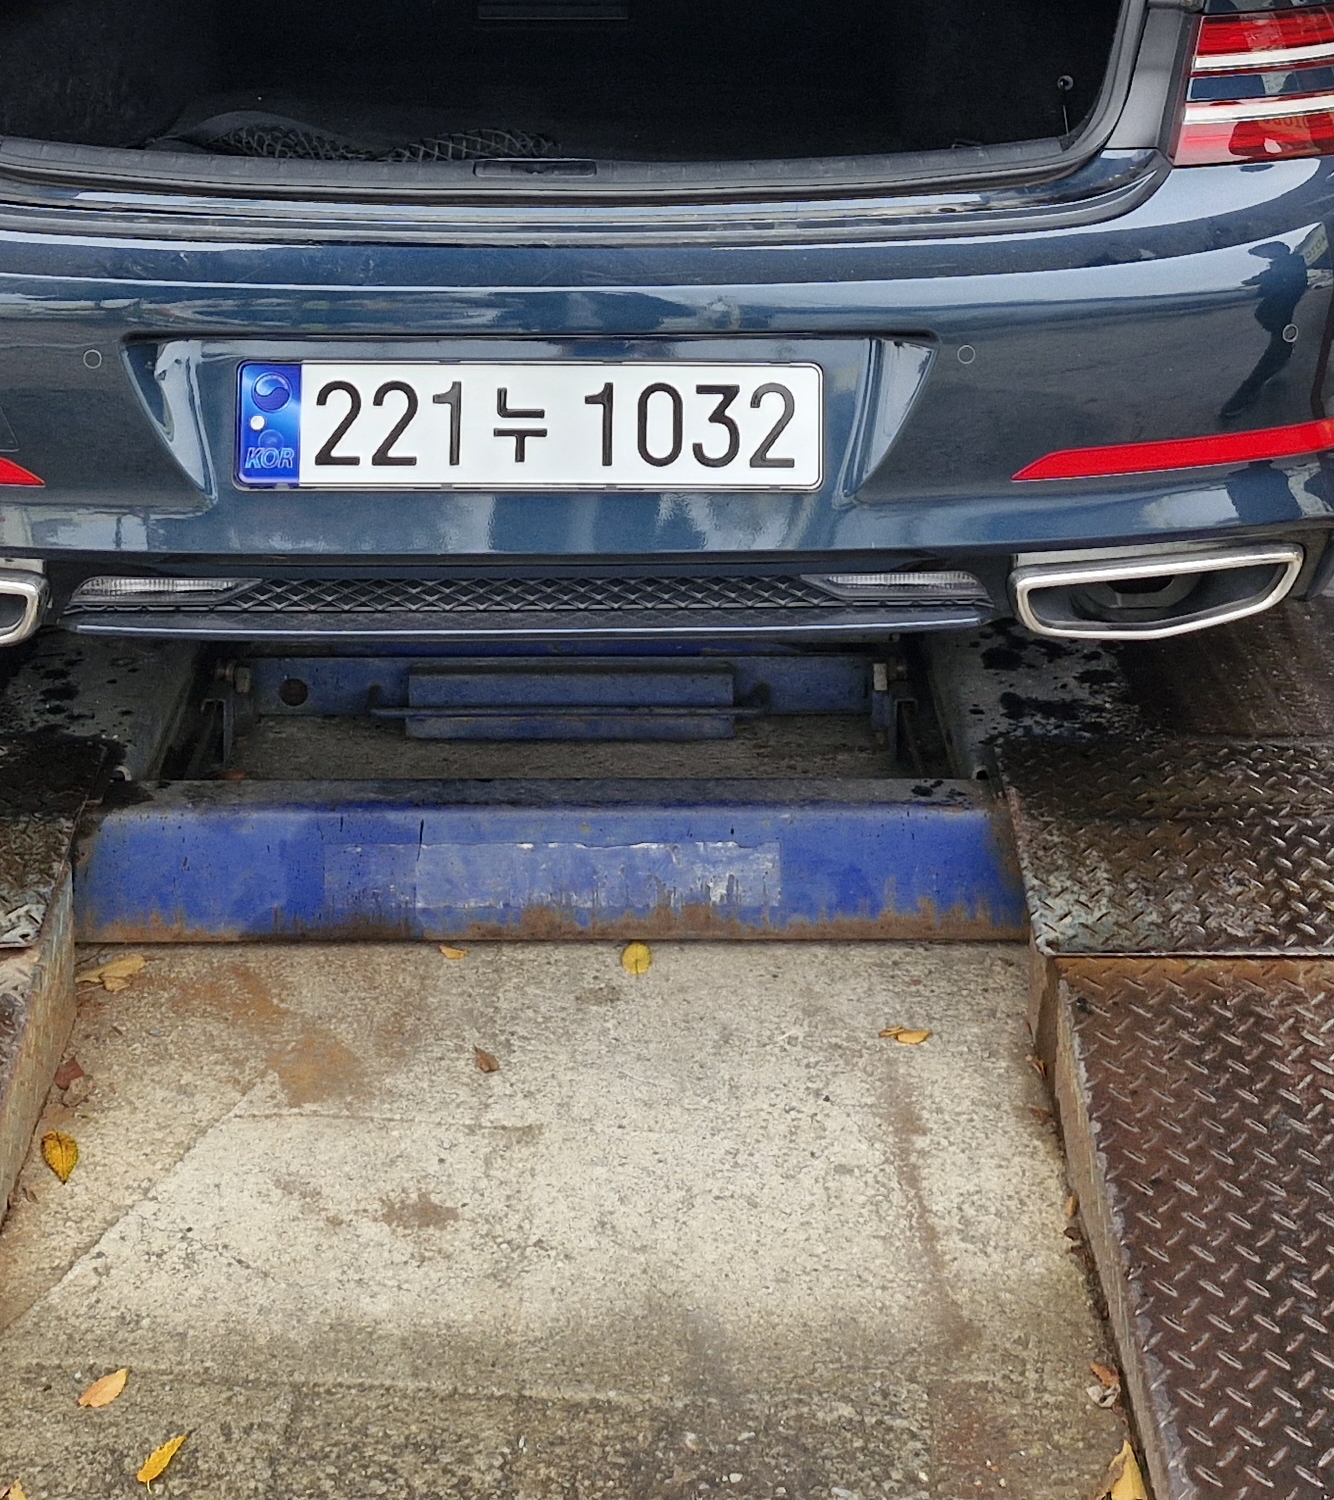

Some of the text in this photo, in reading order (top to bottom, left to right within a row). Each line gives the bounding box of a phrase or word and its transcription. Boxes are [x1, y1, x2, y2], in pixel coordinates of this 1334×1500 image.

[314, 381, 795, 468] 221누 1032
[245, 447, 295, 469] KOR
